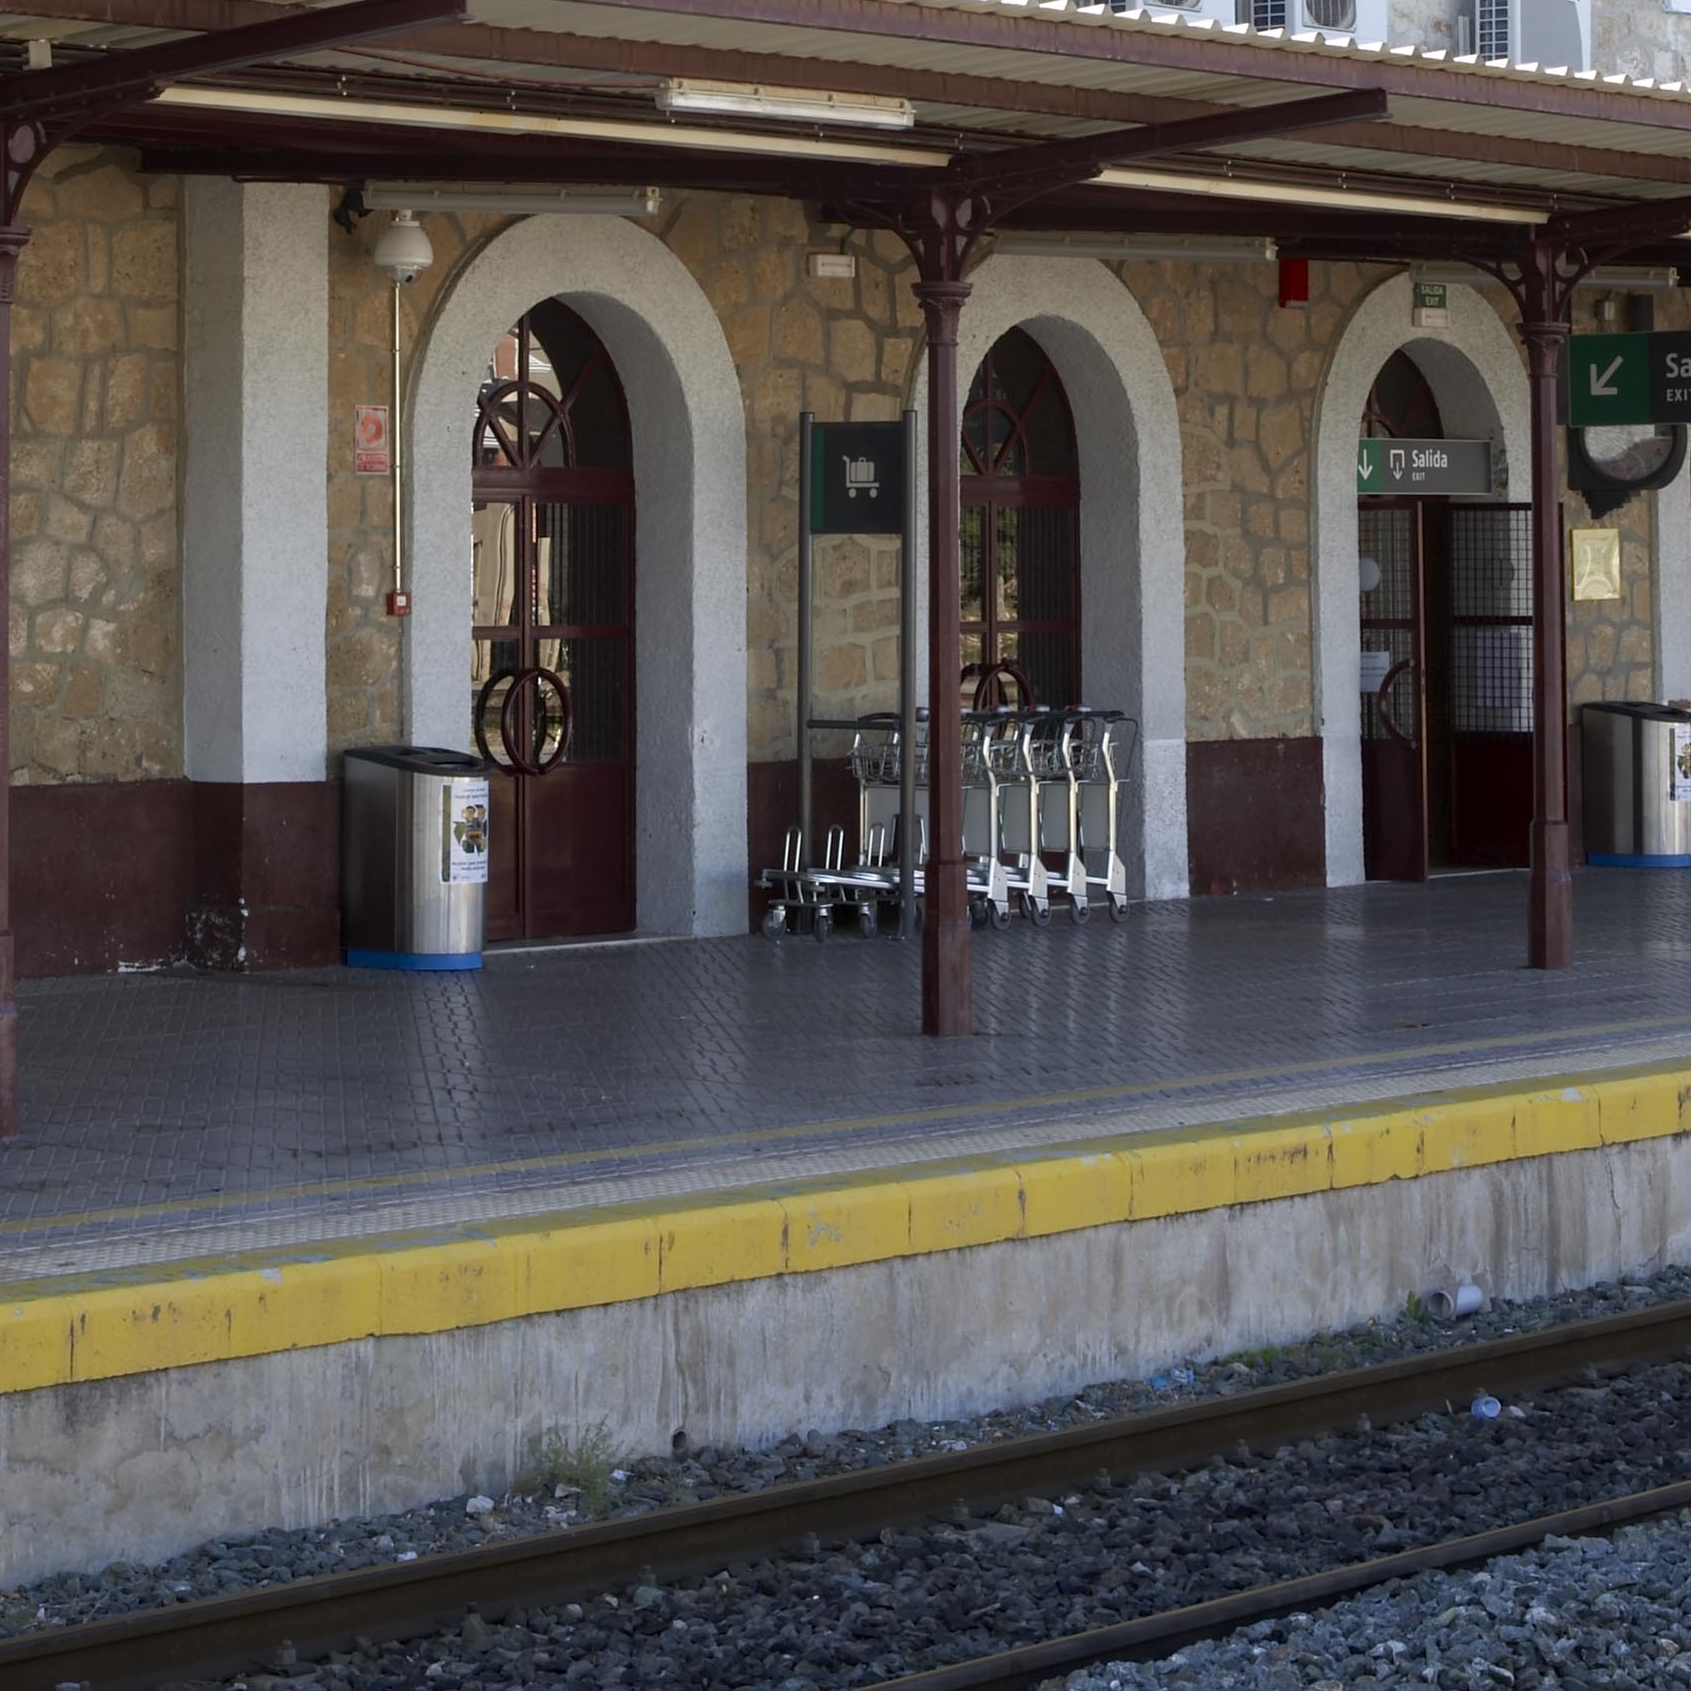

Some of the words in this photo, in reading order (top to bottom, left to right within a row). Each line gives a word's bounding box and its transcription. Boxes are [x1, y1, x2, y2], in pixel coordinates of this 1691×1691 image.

[1421, 284, 1444, 295] SALIDA
[1425, 296, 1440, 307] EXIT
[1412, 448, 1448, 469] Salida
[1412, 472, 1426, 481] EXIT
